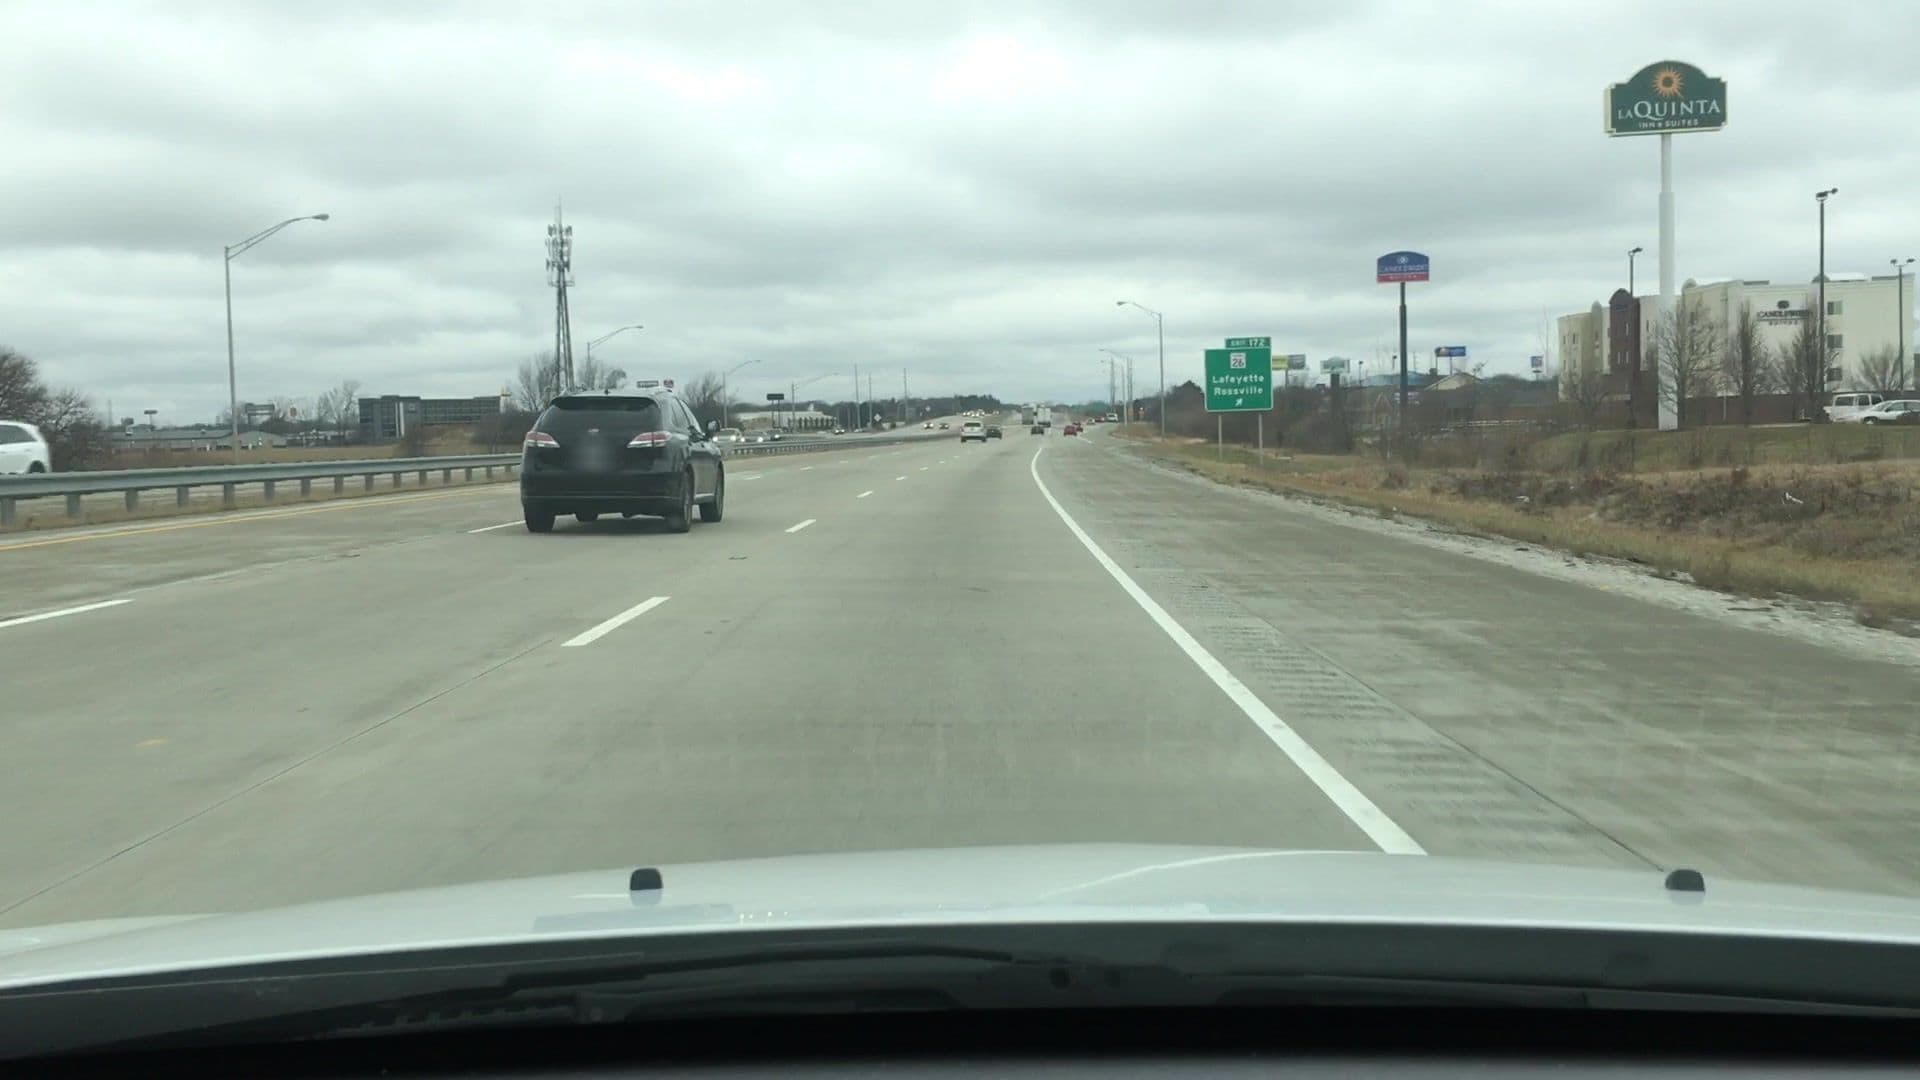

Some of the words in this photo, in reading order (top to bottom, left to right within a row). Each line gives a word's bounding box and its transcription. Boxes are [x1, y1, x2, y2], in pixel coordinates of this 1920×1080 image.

[1633, 100, 1720, 121] QUINTA
[1639, 121, 1656, 129] INN
[1665, 119, 1699, 128] SUITES
[1249, 338, 1265, 348] 172
[1231, 358, 1245, 368] 26
[1212, 374, 1265, 384] Lafayette
[1214, 386, 1264, 396] Rossville
